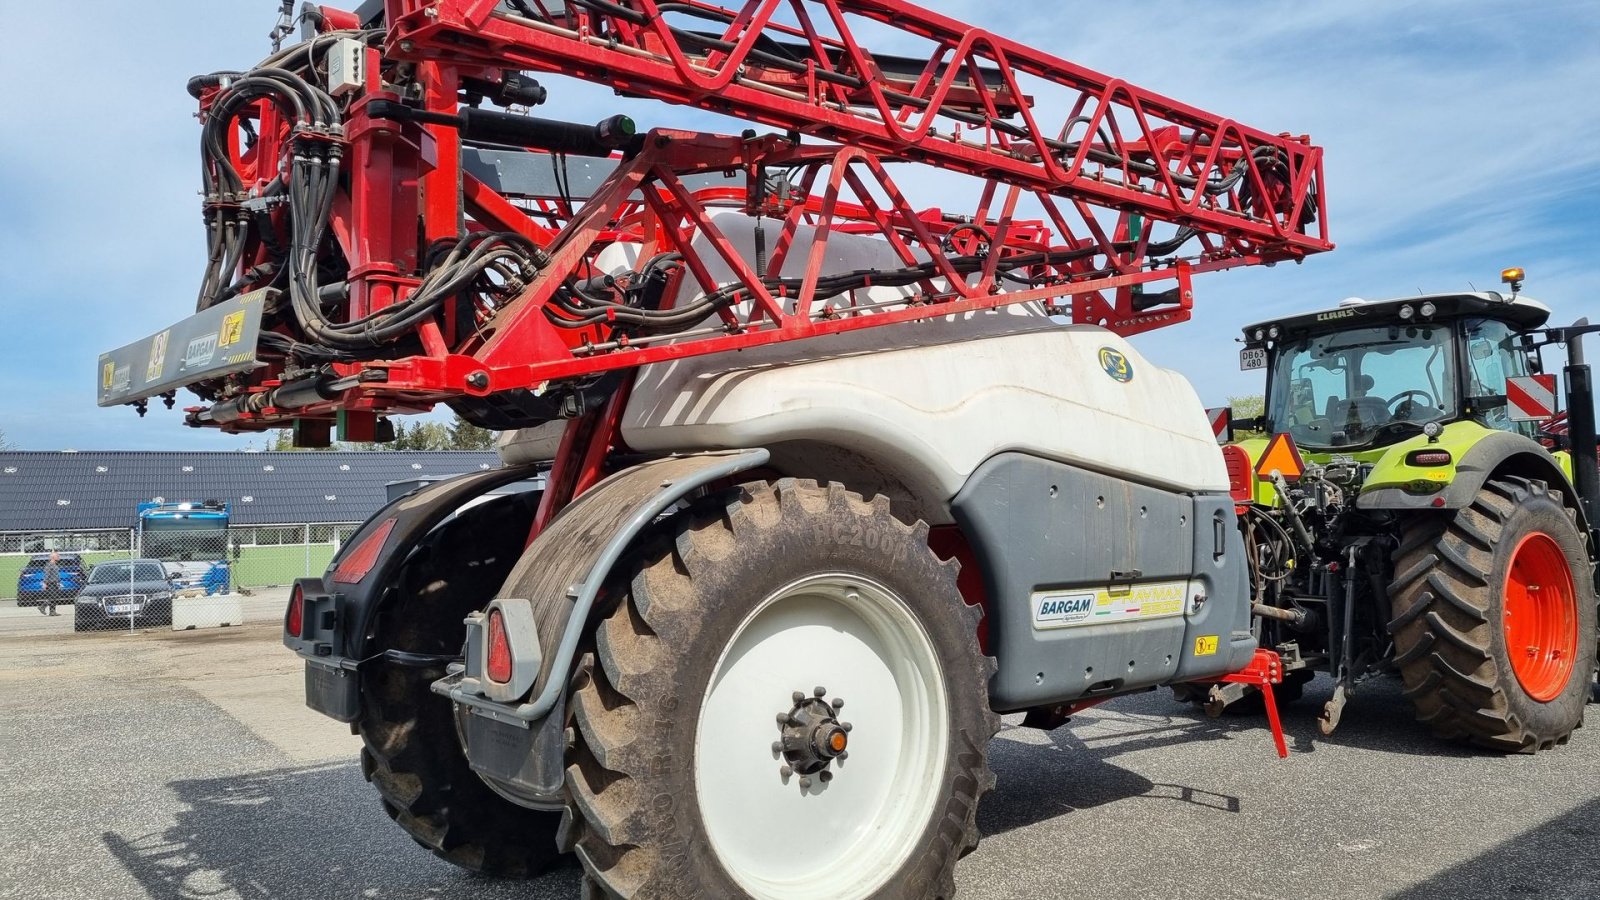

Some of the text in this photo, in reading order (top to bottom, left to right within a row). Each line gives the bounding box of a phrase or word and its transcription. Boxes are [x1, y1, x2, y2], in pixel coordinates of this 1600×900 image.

[1317, 308, 1354, 321] CLAAS
[1242, 349, 1265, 360] DB63
[1246, 358, 1262, 368] 480
[1040, 598, 1091, 615] BARGAM
